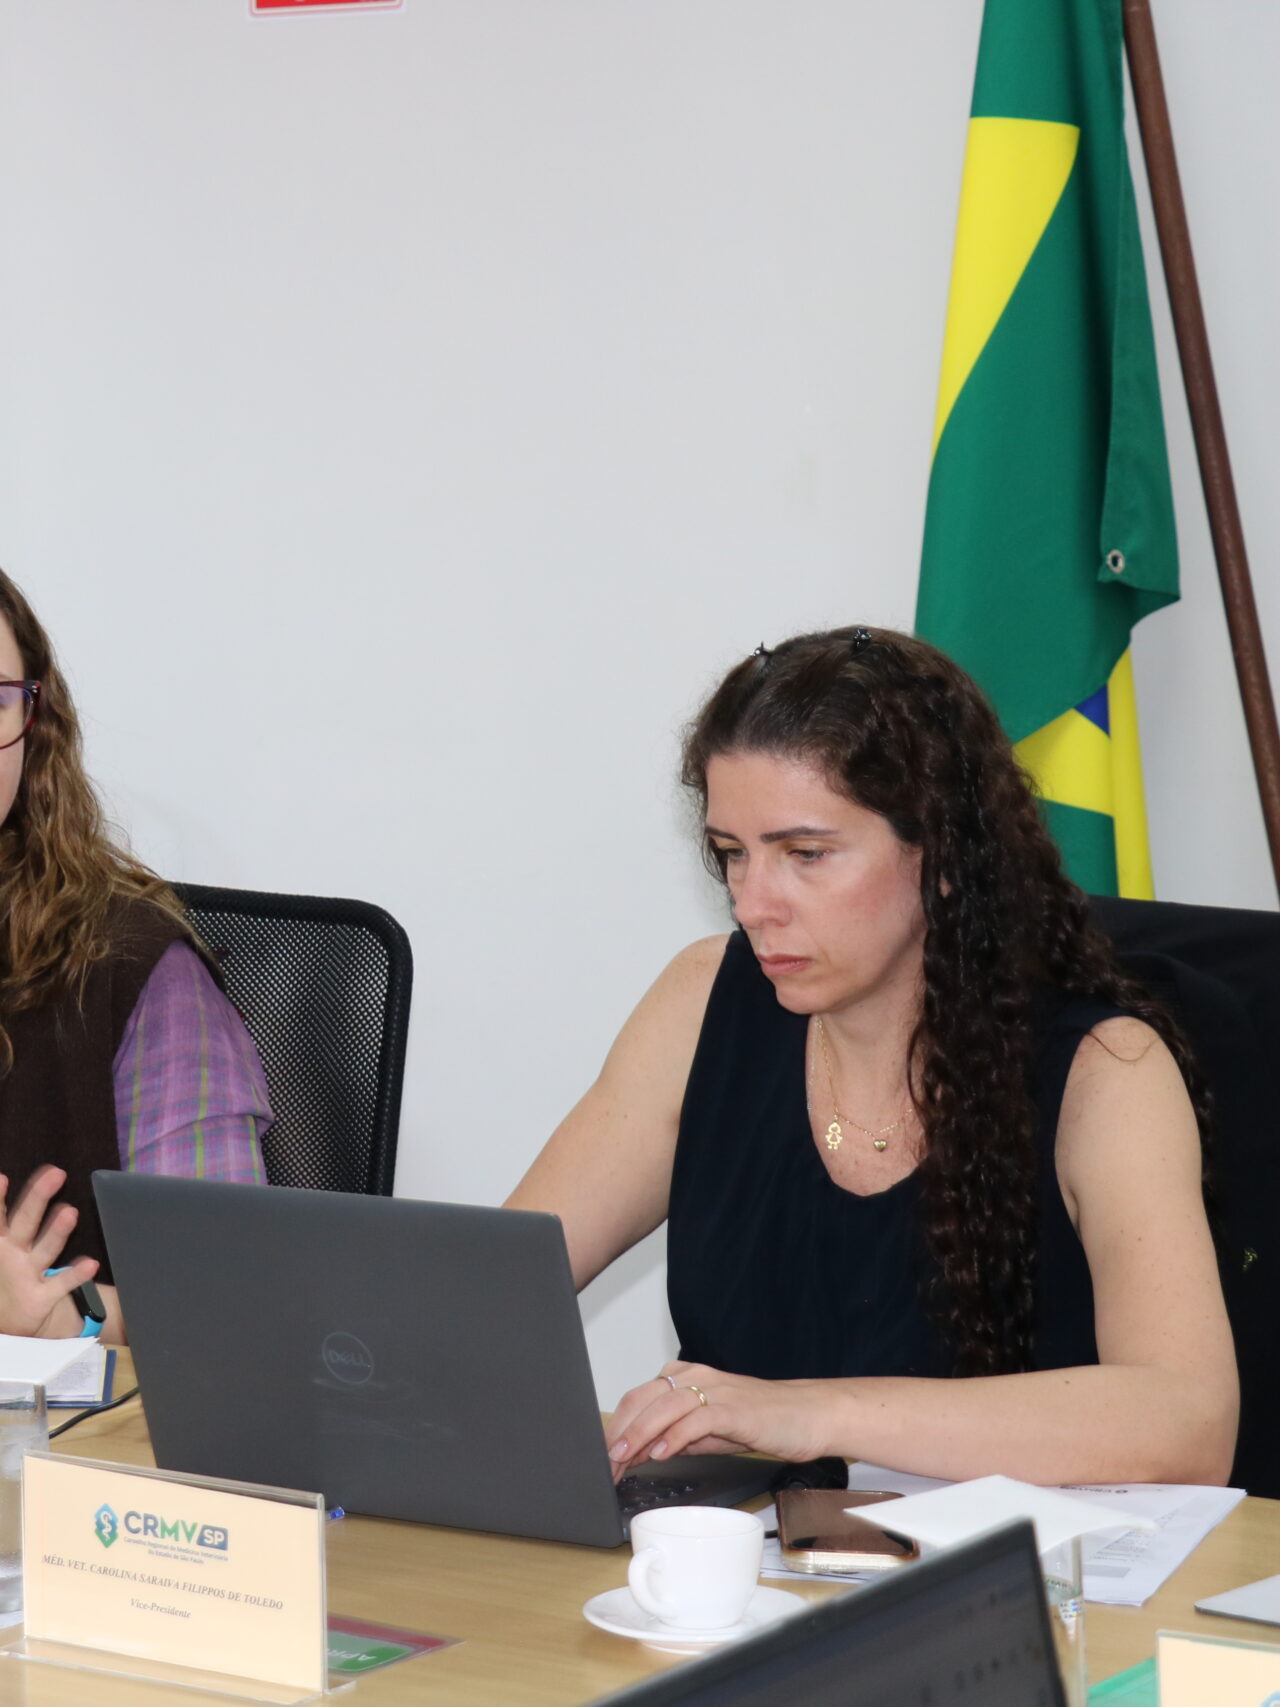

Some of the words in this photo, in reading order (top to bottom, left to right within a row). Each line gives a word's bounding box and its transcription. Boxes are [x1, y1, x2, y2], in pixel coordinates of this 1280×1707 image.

[124, 1511, 198, 1543] CRMV
[42, 1554, 65, 1567] MÉD.
[67, 1559, 87, 1571] VET.
[90, 1564, 138, 1581] CAROLINA
[139, 1573, 180, 1590] SARAIVA
[182, 1582, 226, 1599] FILIPPOS
[227, 1591, 241, 1602] DE
[243, 1594, 284, 1610] TOLEDO
[130, 1598, 191, 1619] Vice-Presidente
